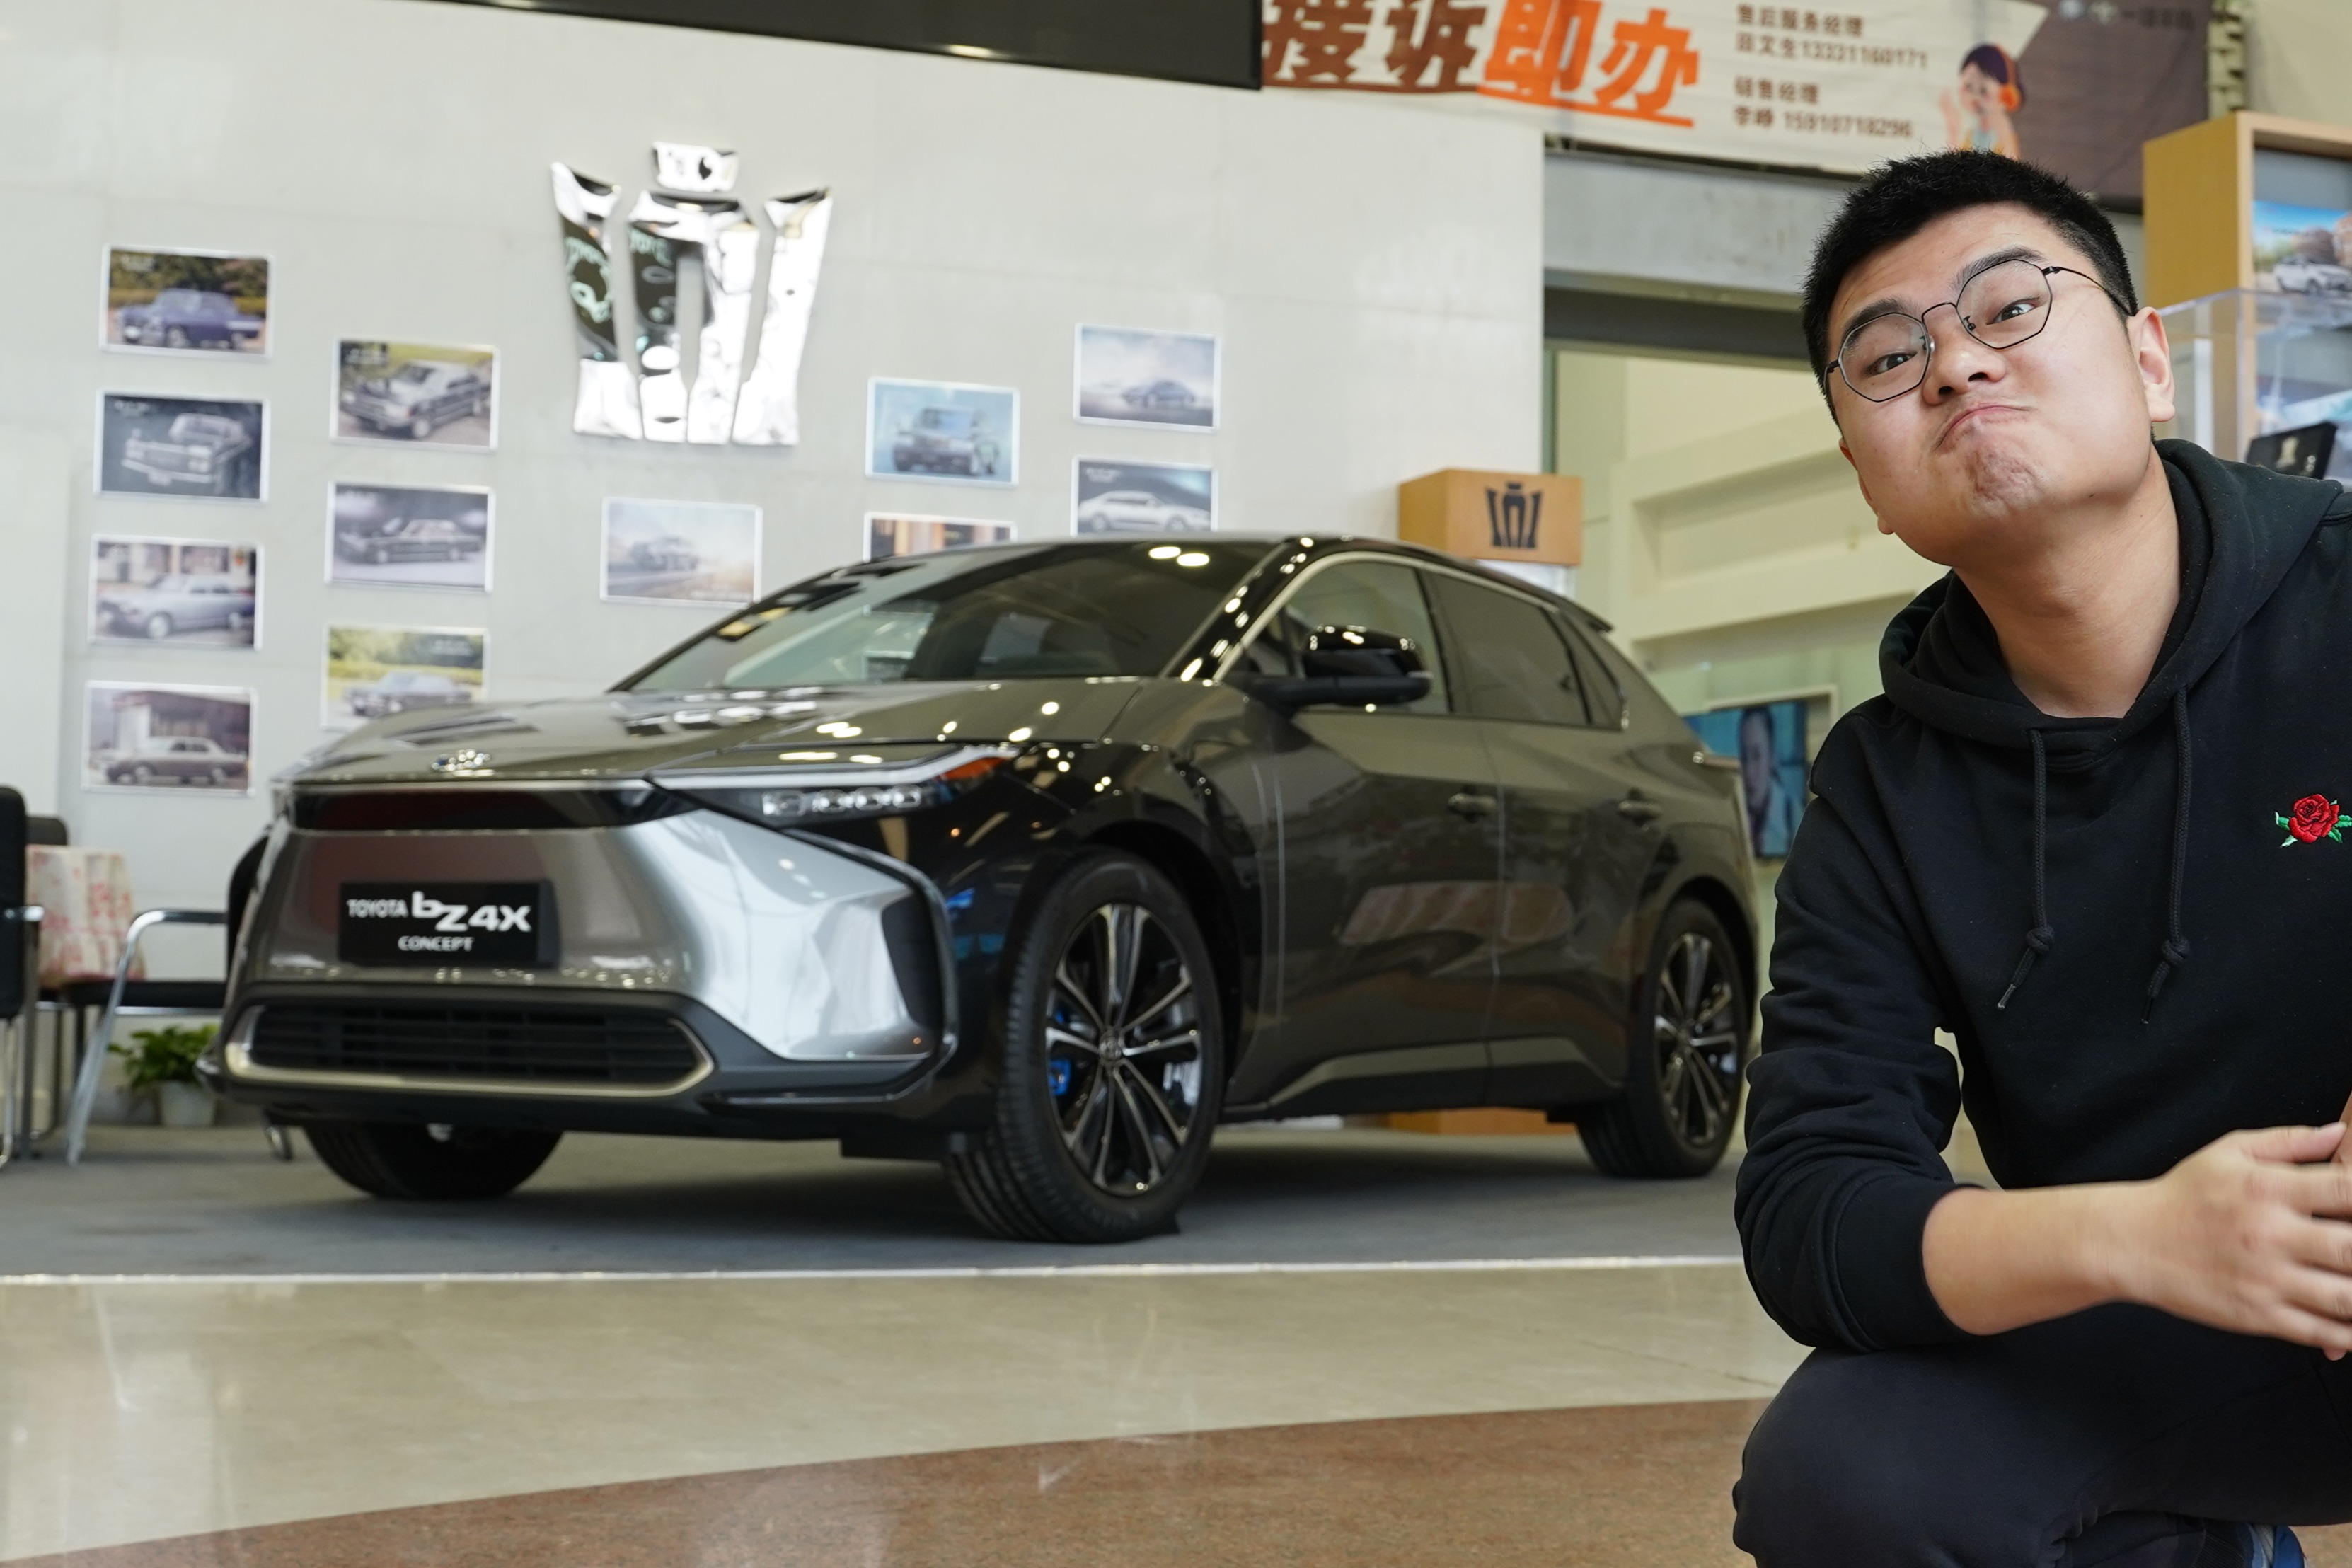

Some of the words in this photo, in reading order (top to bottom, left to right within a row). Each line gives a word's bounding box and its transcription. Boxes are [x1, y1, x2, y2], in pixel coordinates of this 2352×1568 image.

[1737, 4, 1864, 36] 售后服务经理
[1262, 0, 1700, 112] 接诉即办
[1734, 76, 1818, 104] 销售经理
[347, 899, 408, 918] TOYOTA
[398, 935, 475, 952] CONCEPT
